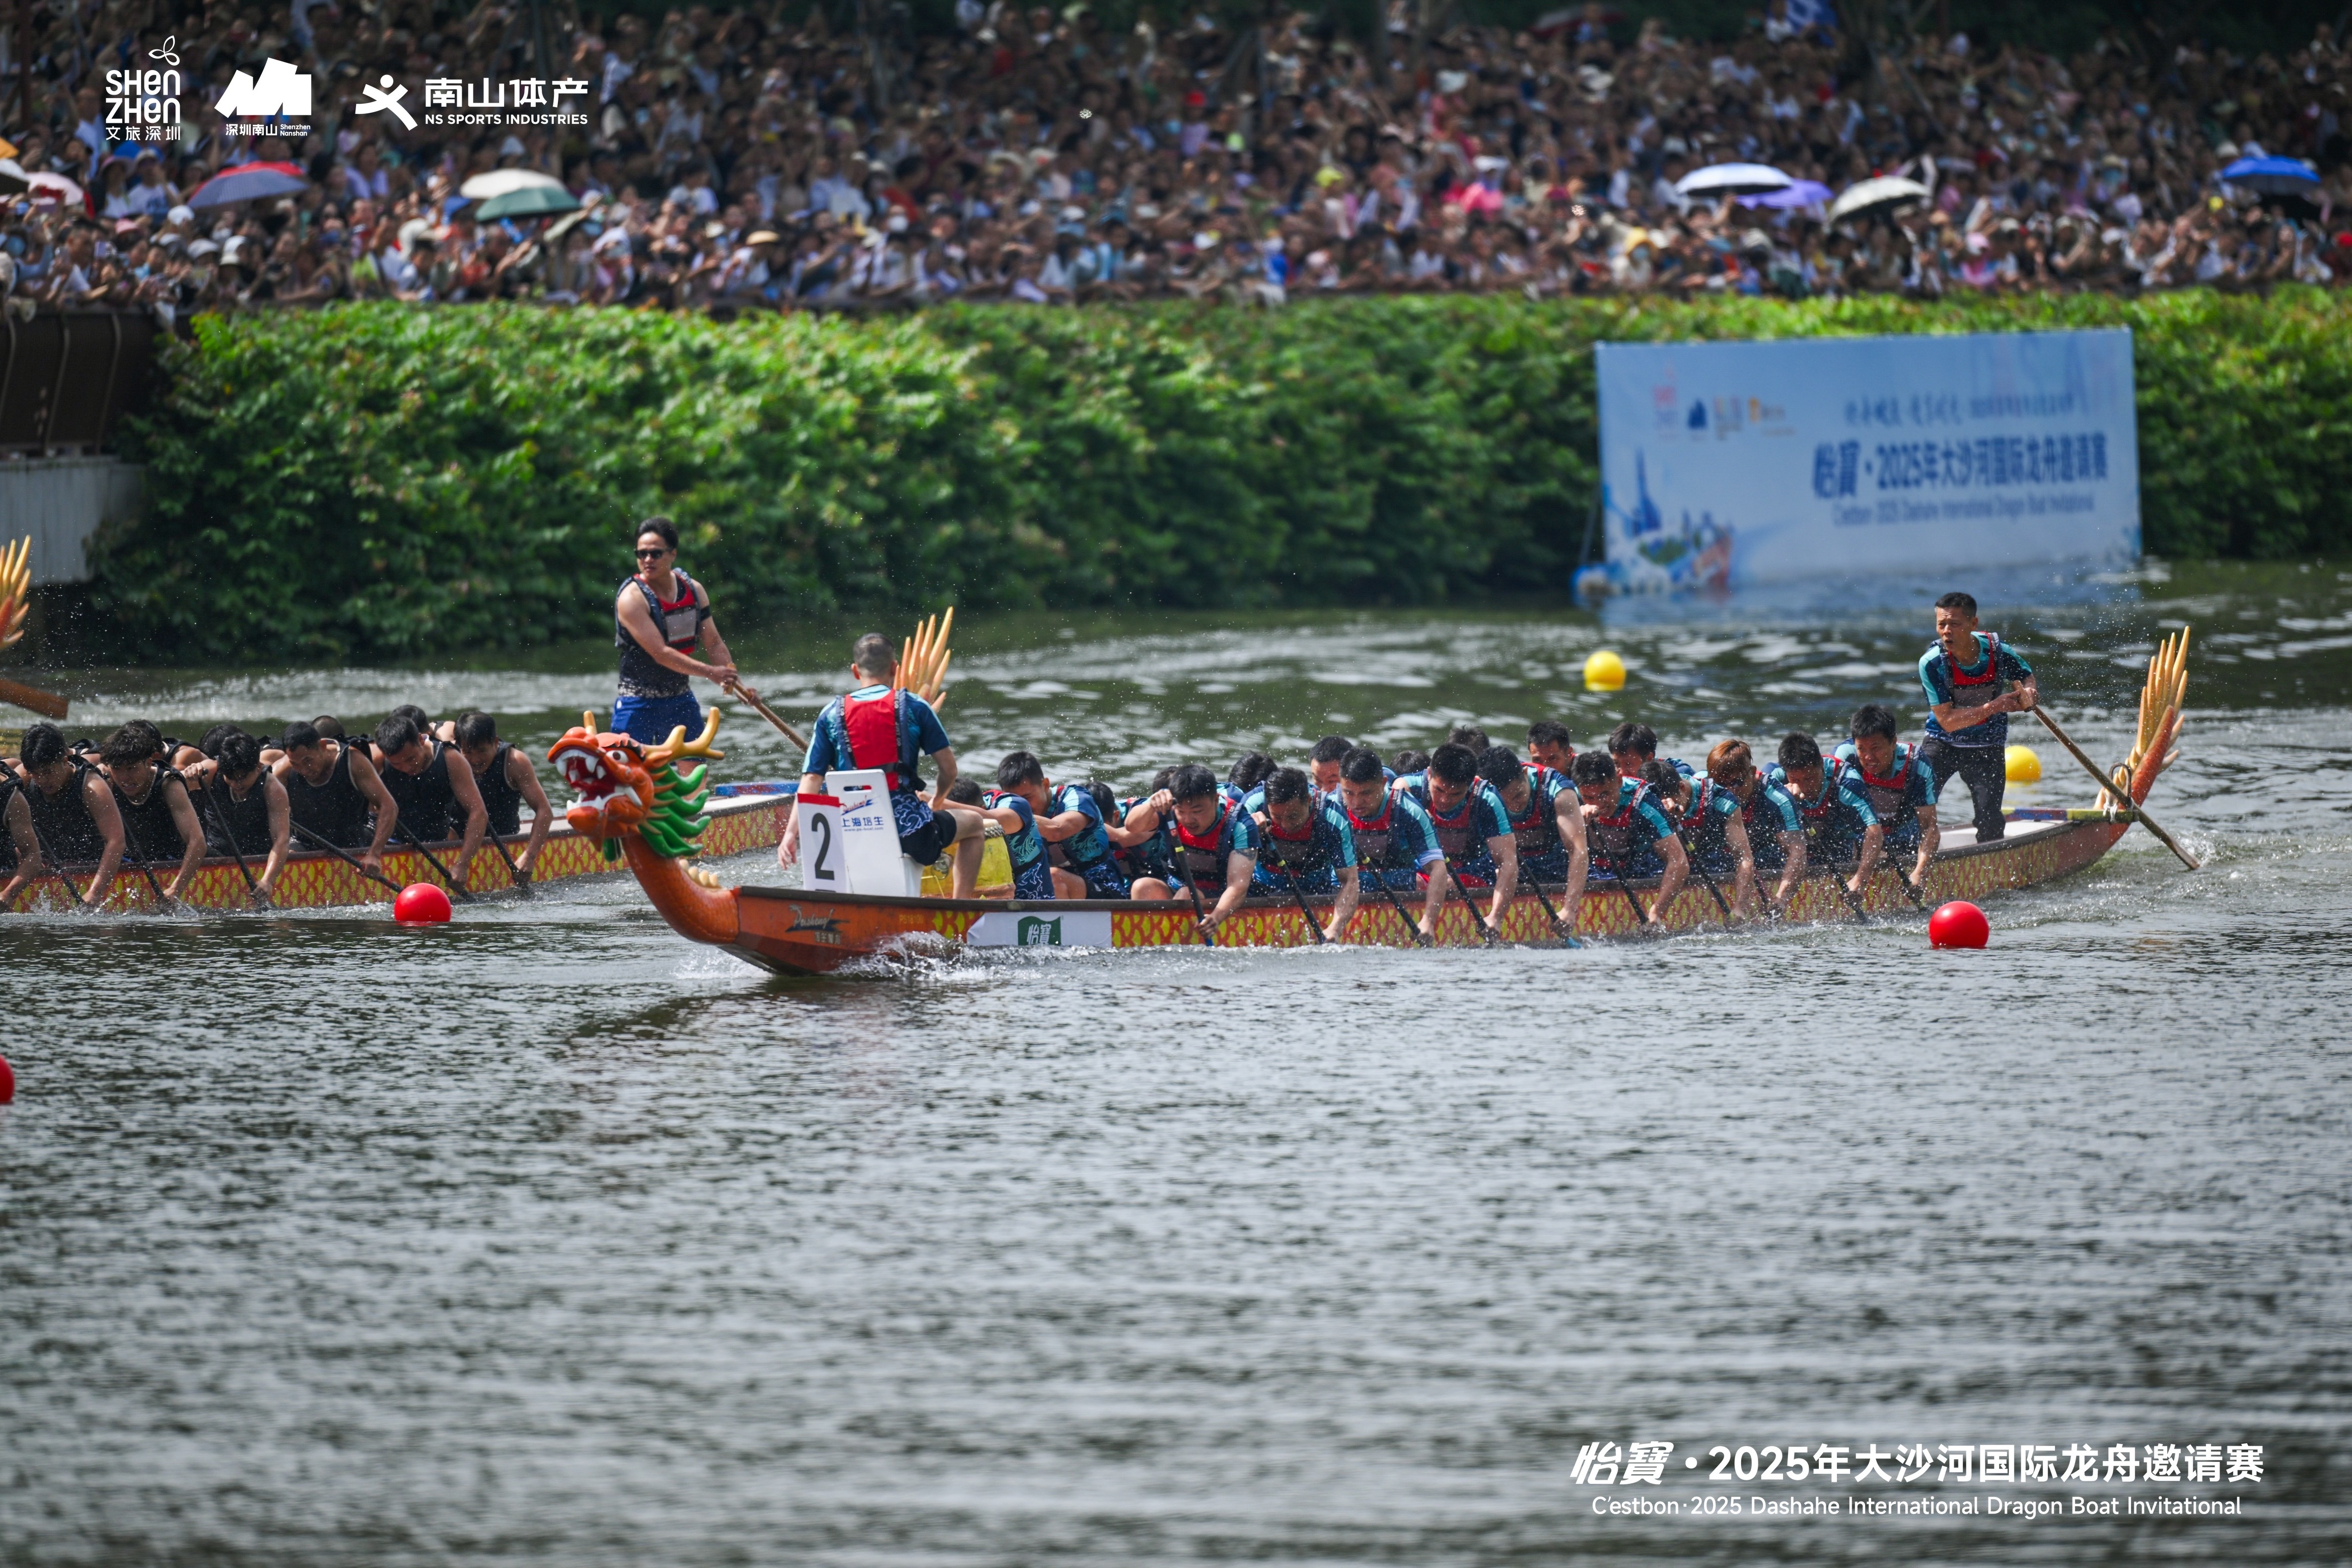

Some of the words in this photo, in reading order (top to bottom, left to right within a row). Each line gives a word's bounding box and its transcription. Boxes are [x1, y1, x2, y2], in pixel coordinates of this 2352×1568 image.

[841, 816, 884, 827] 上海培生
[811, 813, 835, 881] 2
[1027, 923, 1051, 946] 怡寶
